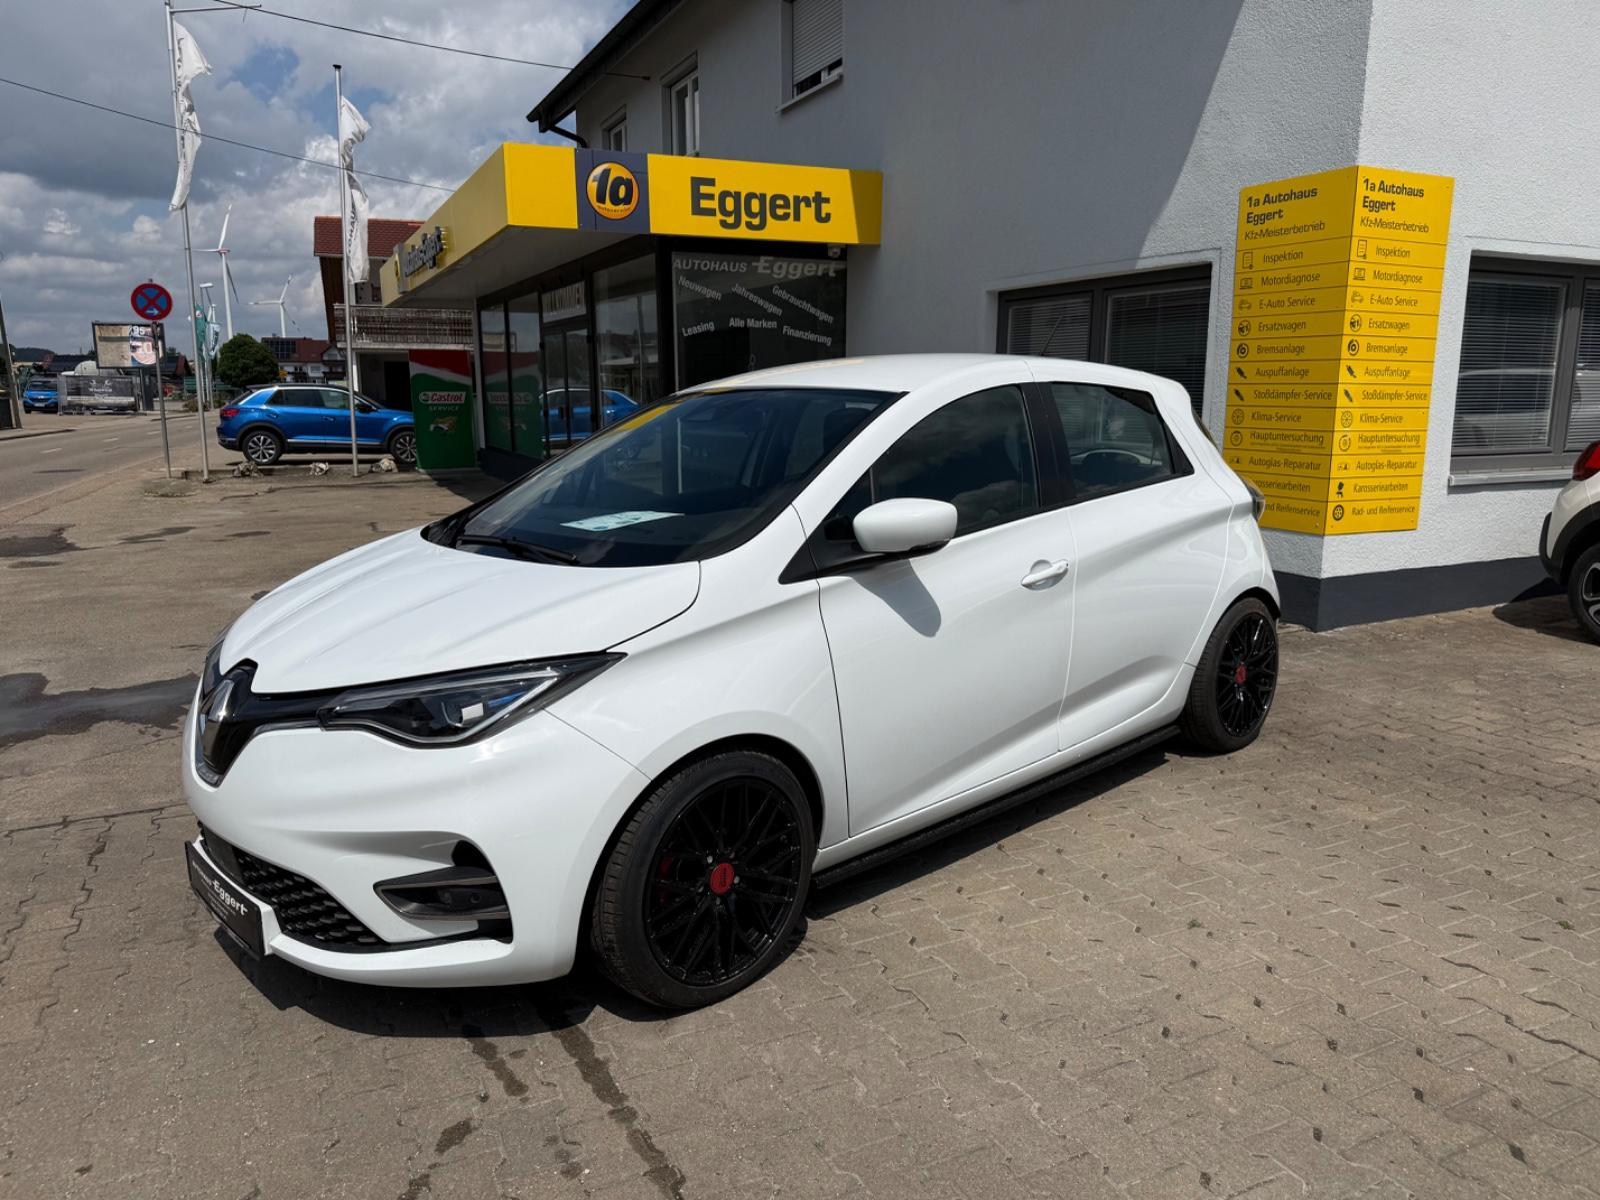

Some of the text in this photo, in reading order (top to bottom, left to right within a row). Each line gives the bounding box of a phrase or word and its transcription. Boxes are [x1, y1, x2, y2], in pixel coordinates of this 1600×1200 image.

[593, 168, 634, 206] 1a
[1363, 178, 1424, 198] 1a Autohaus
[690, 176, 831, 231] Eggert
[1247, 187, 1318, 208] 1a Autohaus
[1362, 196, 1396, 213] Eggert
[1246, 208, 1284, 226] Eggert
[1360, 216, 1430, 233] Kfz-Meisterbetrieb
[1245, 221, 1325, 240] Kfz-Meisterbetrieb
[1263, 250, 1303, 264] Inspektion
[1376, 246, 1410, 259] Inspektion
[672, 256, 847, 280] AUTOHAUS Eggert
[1261, 272, 1321, 287] Motordiagnose
[1373, 270, 1423, 284] Motordiagnose
[678, 275, 722, 300] Neuwagen
[731, 283, 783, 316] Jahreswagen
[772, 284, 834, 324] Gebrauchtwagen
[1259, 294, 1316, 309] E-Auto Service
[1370, 294, 1418, 307] E-Auto Service
[682, 320, 715, 337] Leasing
[729, 317, 777, 329] Alle Marken
[1258, 320, 1306, 333] Ersatzwagen
[1368, 318, 1410, 331] Ersatzwagen
[782, 325, 832, 346] Finanzierung
[1256, 343, 1305, 355] Bremsanlage
[1366, 342, 1408, 355] Bremsanlage
[1255, 366, 1310, 378] Auspuffanlage
[1364, 366, 1411, 378] Auspuffanlage
[431, 392, 463, 402] Castrol
[1251, 411, 1302, 423] Klima-Service
[1359, 413, 1403, 424] Klima-Service
[1250, 431, 1324, 446] Hauptuntersuchung
[1249, 456, 1321, 471] Autoglas-Reparatur
[1255, 479, 1311, 493] rosseriearbeiten
[1276, 503, 1321, 517] Reifenservice
[1366, 506, 1378, 515] und
[212, 879, 248, 915] Eggert
